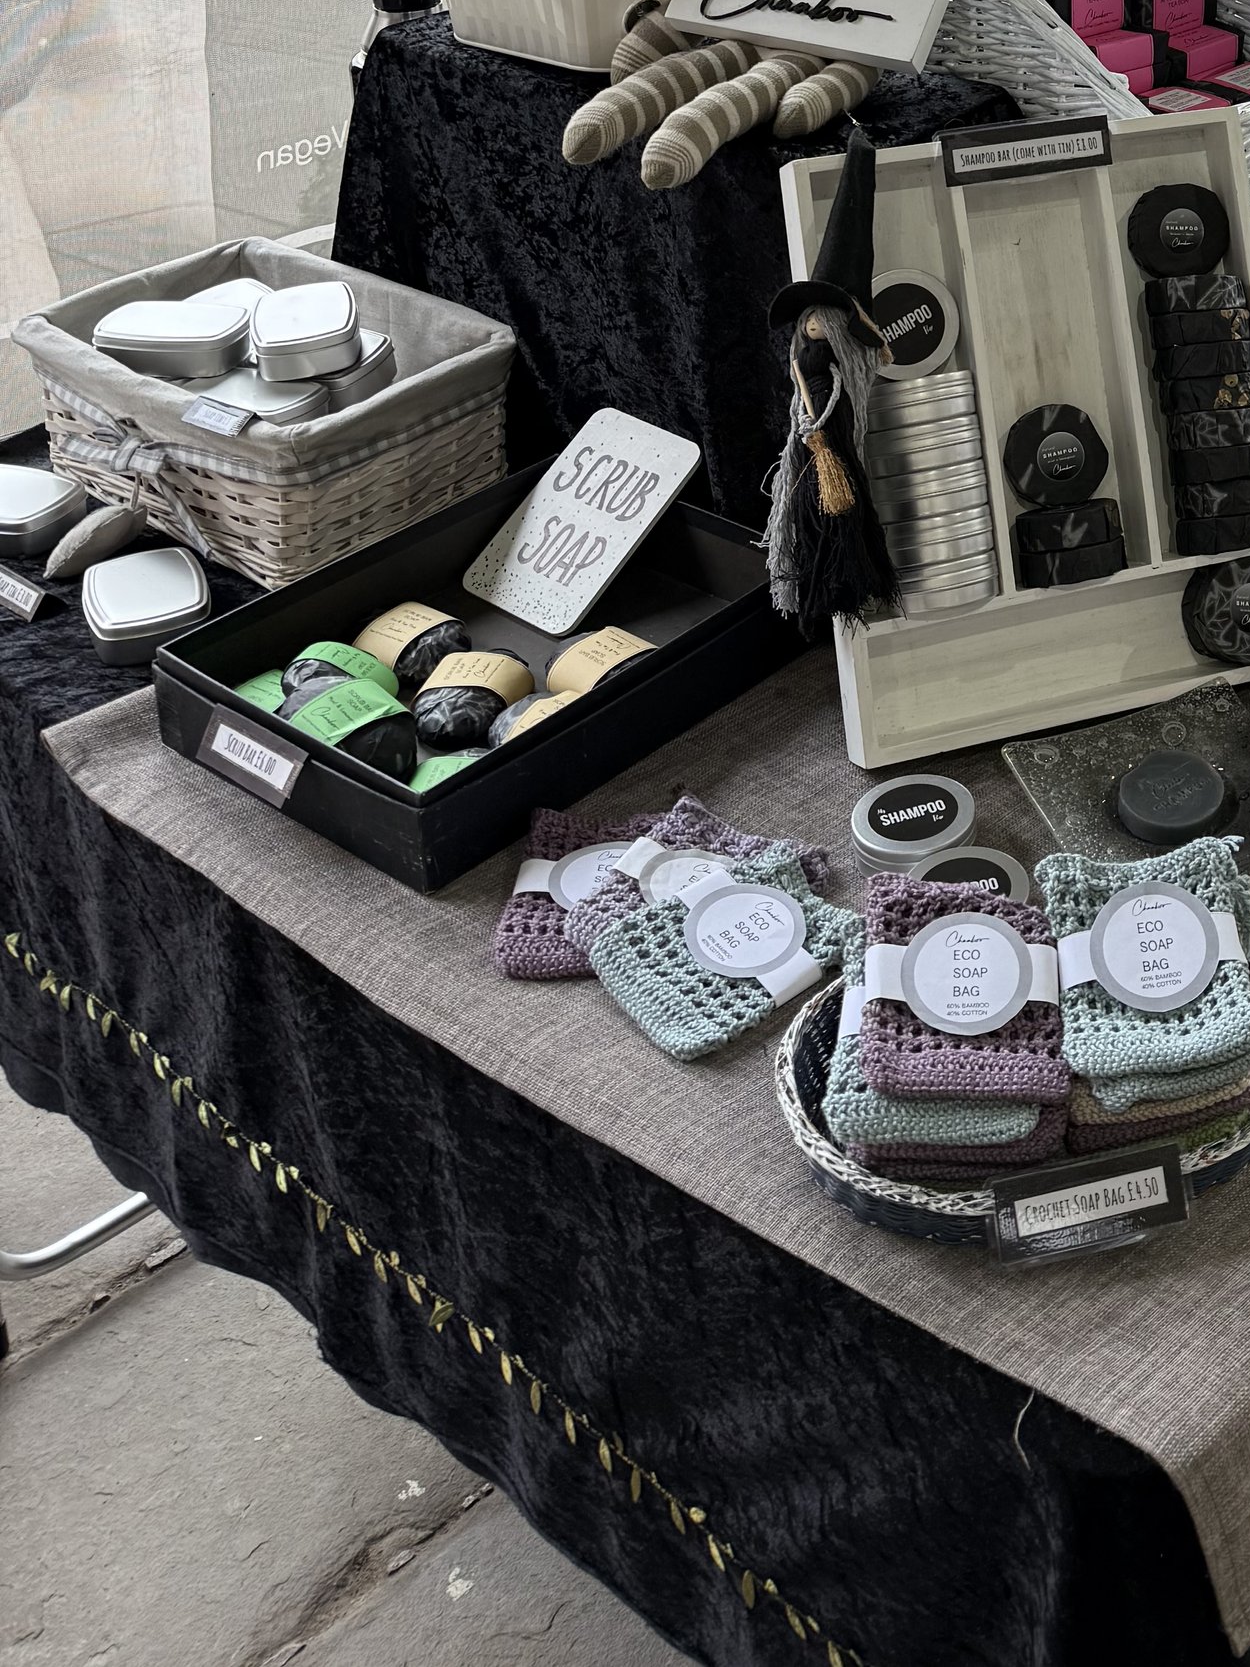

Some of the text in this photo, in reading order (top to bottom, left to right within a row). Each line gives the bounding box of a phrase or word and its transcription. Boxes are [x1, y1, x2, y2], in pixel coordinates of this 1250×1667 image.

[960, 152, 996, 168] SHAMPOO
[997, 149, 1011, 162] BAR
[1037, 143, 1057, 157] WITH
[881, 304, 933, 343] HAMPOO
[1043, 446, 1078, 459] SHAMPOO
[553, 446, 660, 522] SCRUB
[517, 515, 607, 587] SOAP
[879, 799, 947, 827] SHAMPOO
[748, 912, 770, 931] ECO
[1136, 919, 1164, 935] ECO
[719, 930, 741, 949] BAG
[734, 921, 760, 943] SOAP
[1140, 937, 1174, 953] SOAP
[953, 949, 981, 961] ECO
[1142, 957, 1170, 972] BAG
[953, 967, 988, 979] SOAP
[953, 985, 980, 998] BAG
[1025, 1176, 1160, 1225] CROCHET SOAP BAG £4.50
